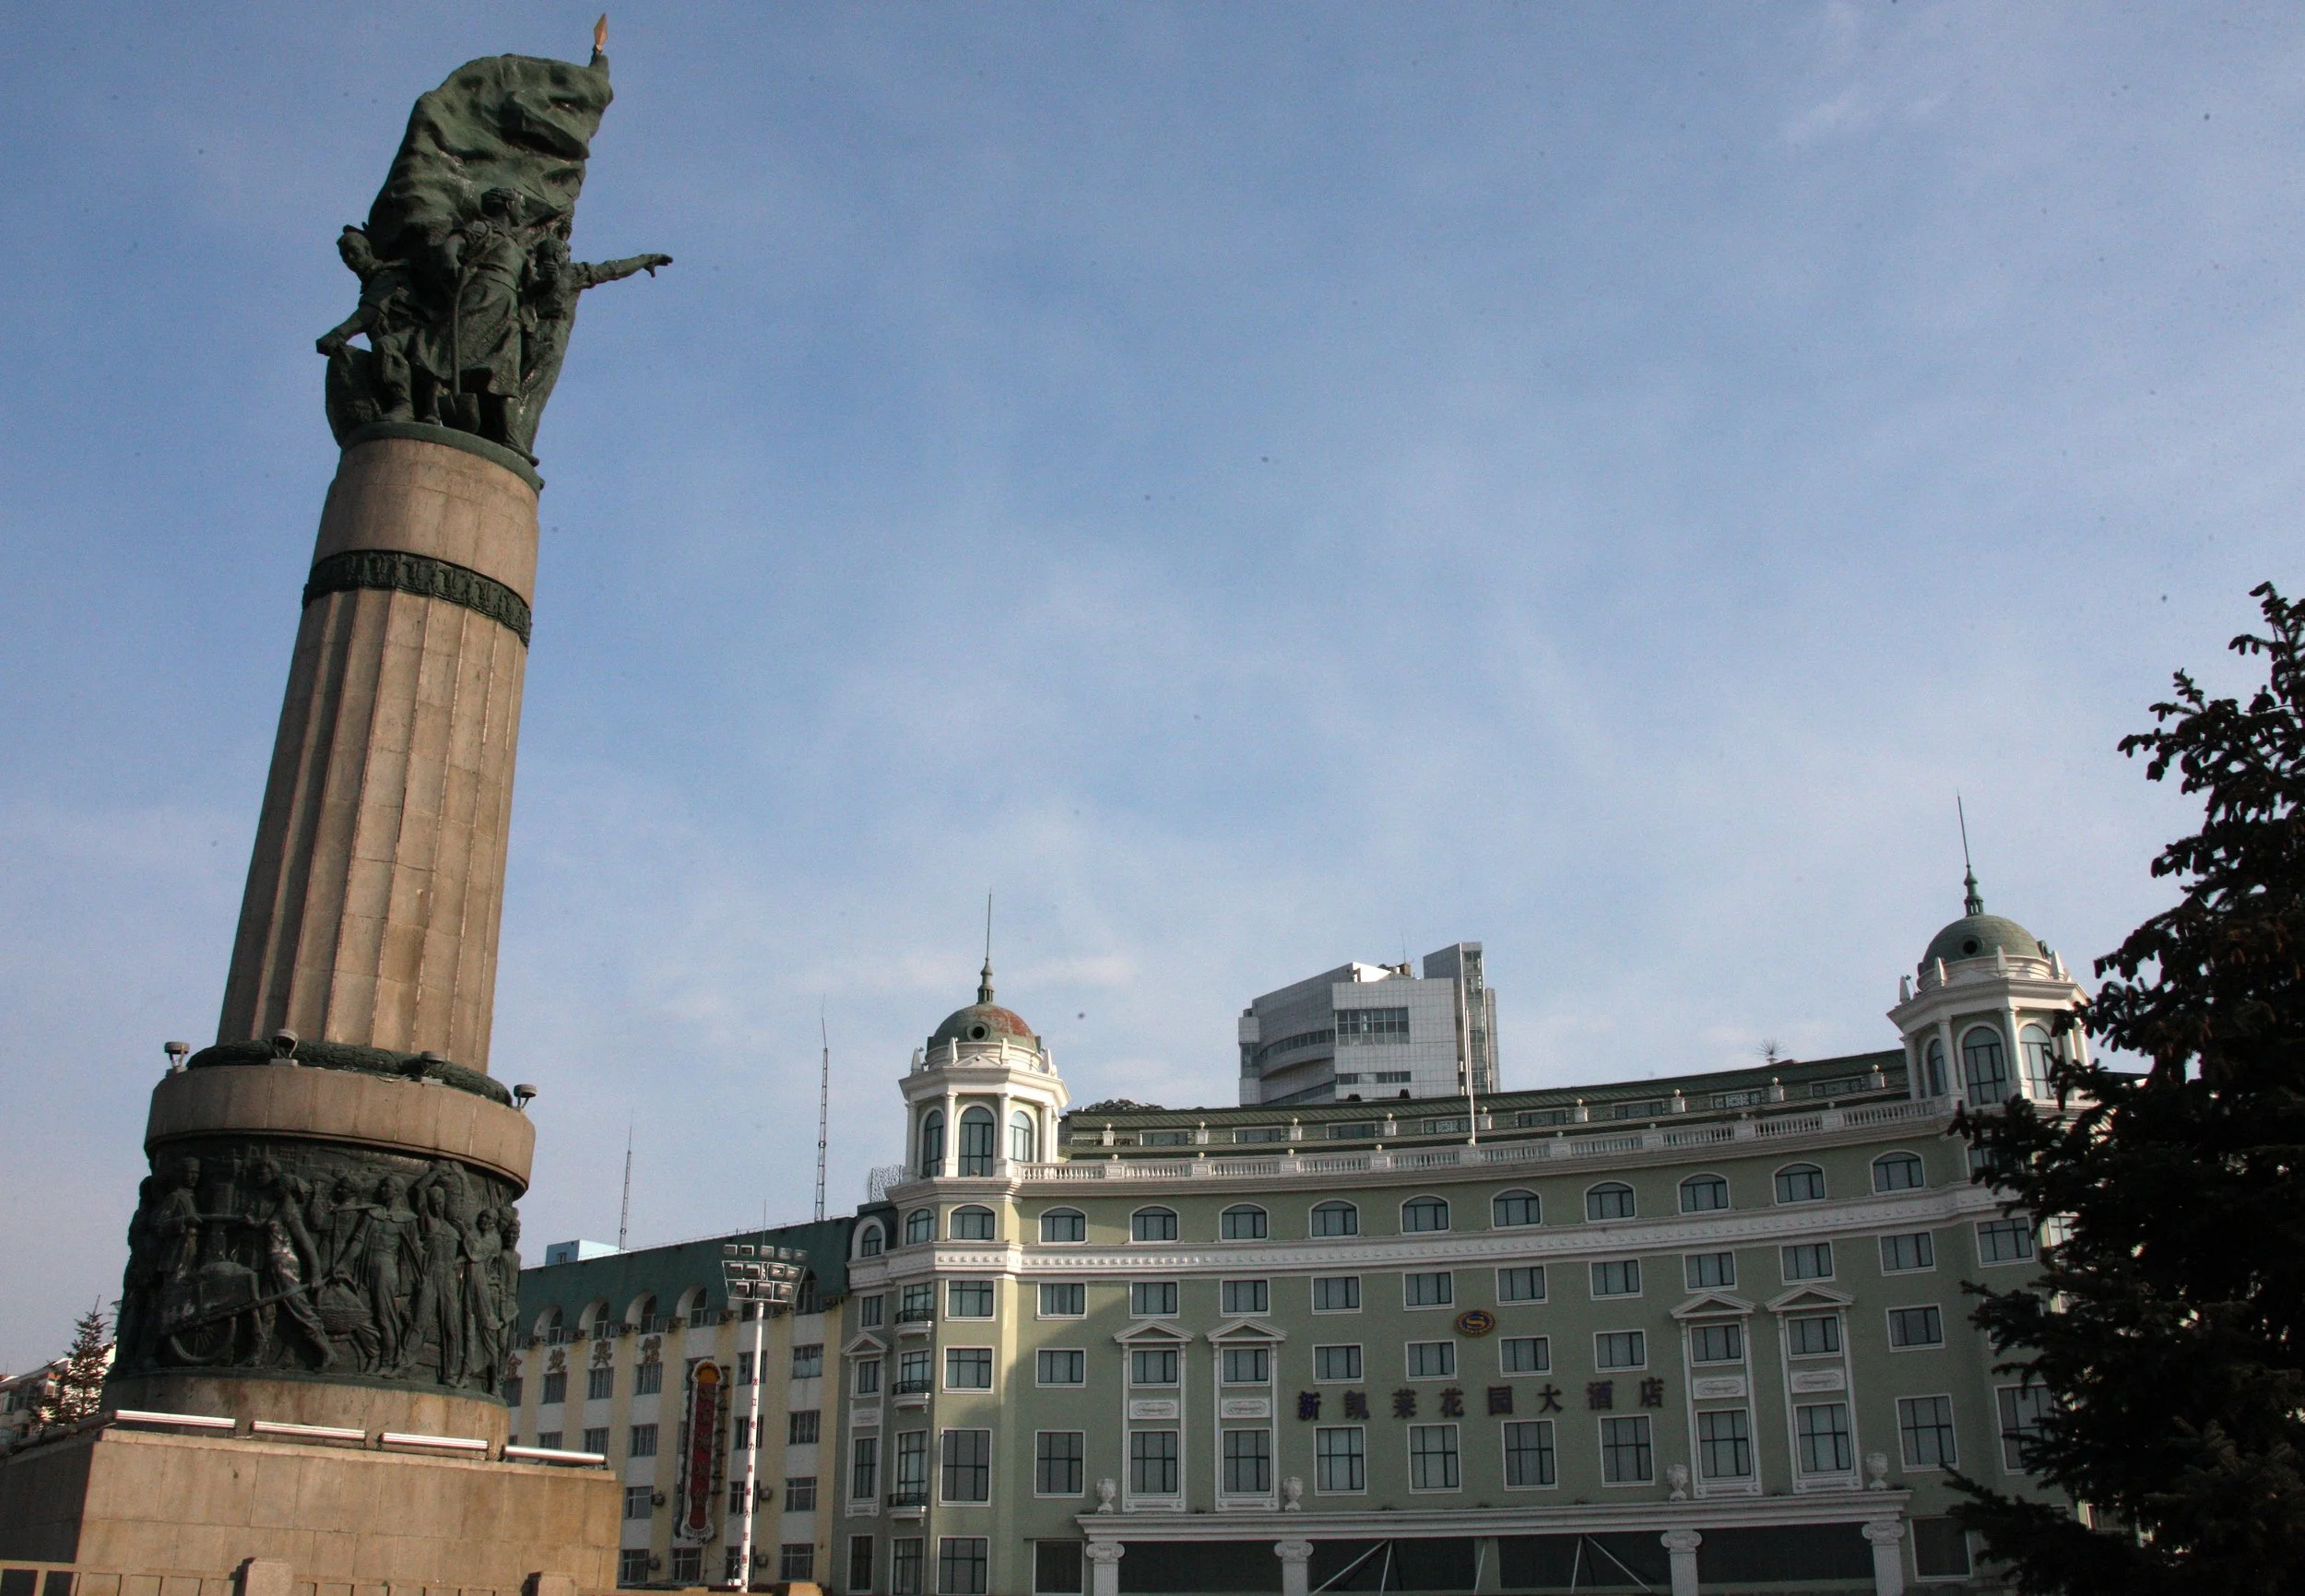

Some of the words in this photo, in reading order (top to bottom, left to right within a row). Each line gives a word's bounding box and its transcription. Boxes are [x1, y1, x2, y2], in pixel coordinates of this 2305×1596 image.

[1298, 1377, 1664, 1421] 新凯莱花园大酒店
